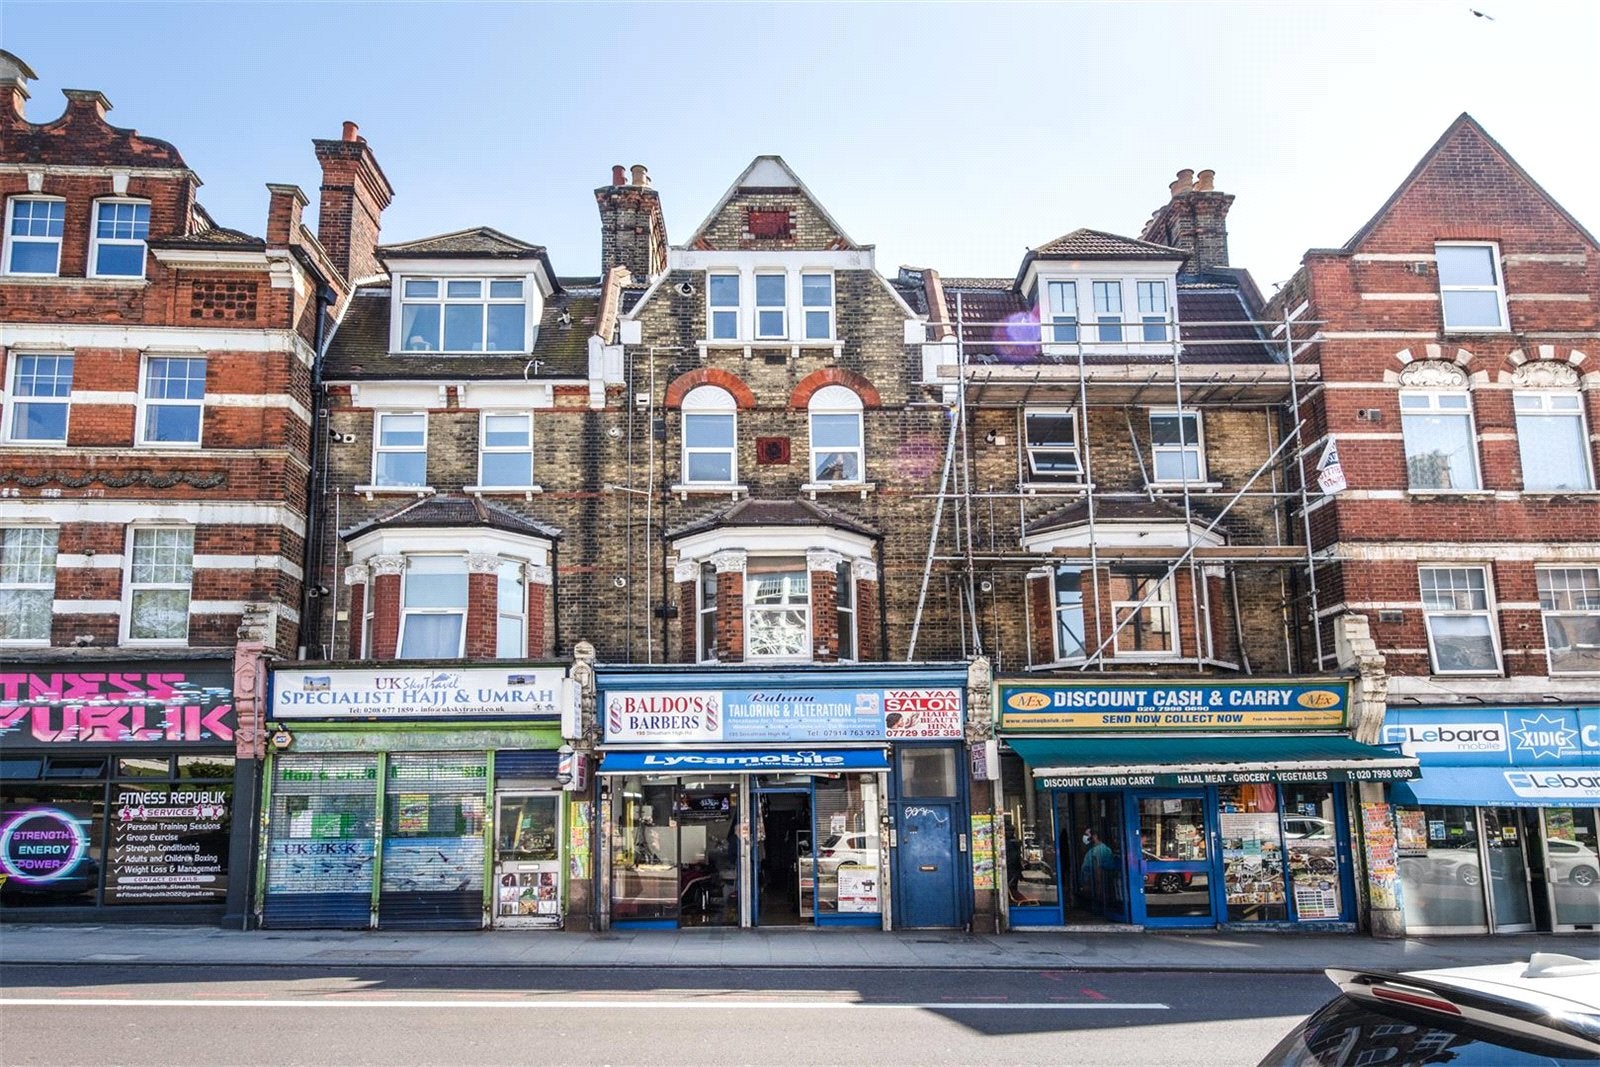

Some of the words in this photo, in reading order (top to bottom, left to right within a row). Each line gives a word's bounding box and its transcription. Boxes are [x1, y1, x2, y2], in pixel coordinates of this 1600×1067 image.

[375, 677, 401, 690] UK
[281, 690, 395, 705] SPECIALIST
[402, 689, 447, 705] HAJJ
[454, 688, 470, 703] &
[478, 689, 553, 703] UMRAH
[1054, 691, 1147, 707] DISCOUNT
[1153, 690, 1203, 706] CASH
[1209, 690, 1223, 706] &
[1229, 690, 1293, 706] CARRY
[624, 696, 703, 714] BALDO'S
[728, 704, 780, 717] TAILORING
[783, 704, 790, 717] &
[793, 703, 851, 717] ALTERATION
[886, 699, 960, 711] SALON
[629, 715, 700, 730] BARBERS
[1102, 715, 1131, 724] SEND
[1135, 715, 1161, 724] NOW
[1165, 714, 1213, 723] COLLECT
[1217, 714, 1243, 723] NOW
[1410, 727, 1500, 742] Lebara
[1524, 731, 1567, 747] XIDIG
[644, 753, 845, 765] Lycamobile
[1177, 775, 1204, 784] HALAL
[1205, 774, 1227, 783] MEAT
[1233, 773, 1269, 782] GROCERY
[1277, 771, 1328, 781] VEGETABLES
[1347, 770, 1355, 780] T:
[1357, 770, 1371, 779] 020
[1373, 770, 1392, 779] 7998
[1393, 769, 1412, 778] 0690
[1043, 778, 1084, 788] DISCOUNT
[1086, 777, 1108, 787] CASH
[1110, 776, 1127, 786] AND
[1128, 776, 1155, 786] CARRY
[119, 792, 166, 805] FITNESS
[170, 791, 226, 804] REPUBLIK
[147, 808, 194, 816] SERVICES
[127, 823, 158, 831] Personal
[160, 823, 188, 832] Training
[189, 822, 221, 830] Sessions
[13, 831, 70, 840] STRENGTH
[126, 834, 148, 842] Group
[149, 833, 179, 841] Exercise
[18, 845, 70, 854] ENERGY
[125, 844, 156, 853] Strength
[158, 843, 200, 853] Conditioning
[18, 860, 60, 869] POWER
[125, 855, 147, 863] Adults
[194, 854, 218, 863] Boxing
[124, 865, 149, 874] Weight
[169, 865, 175, 873] &
[177, 865, 221, 874] Management
